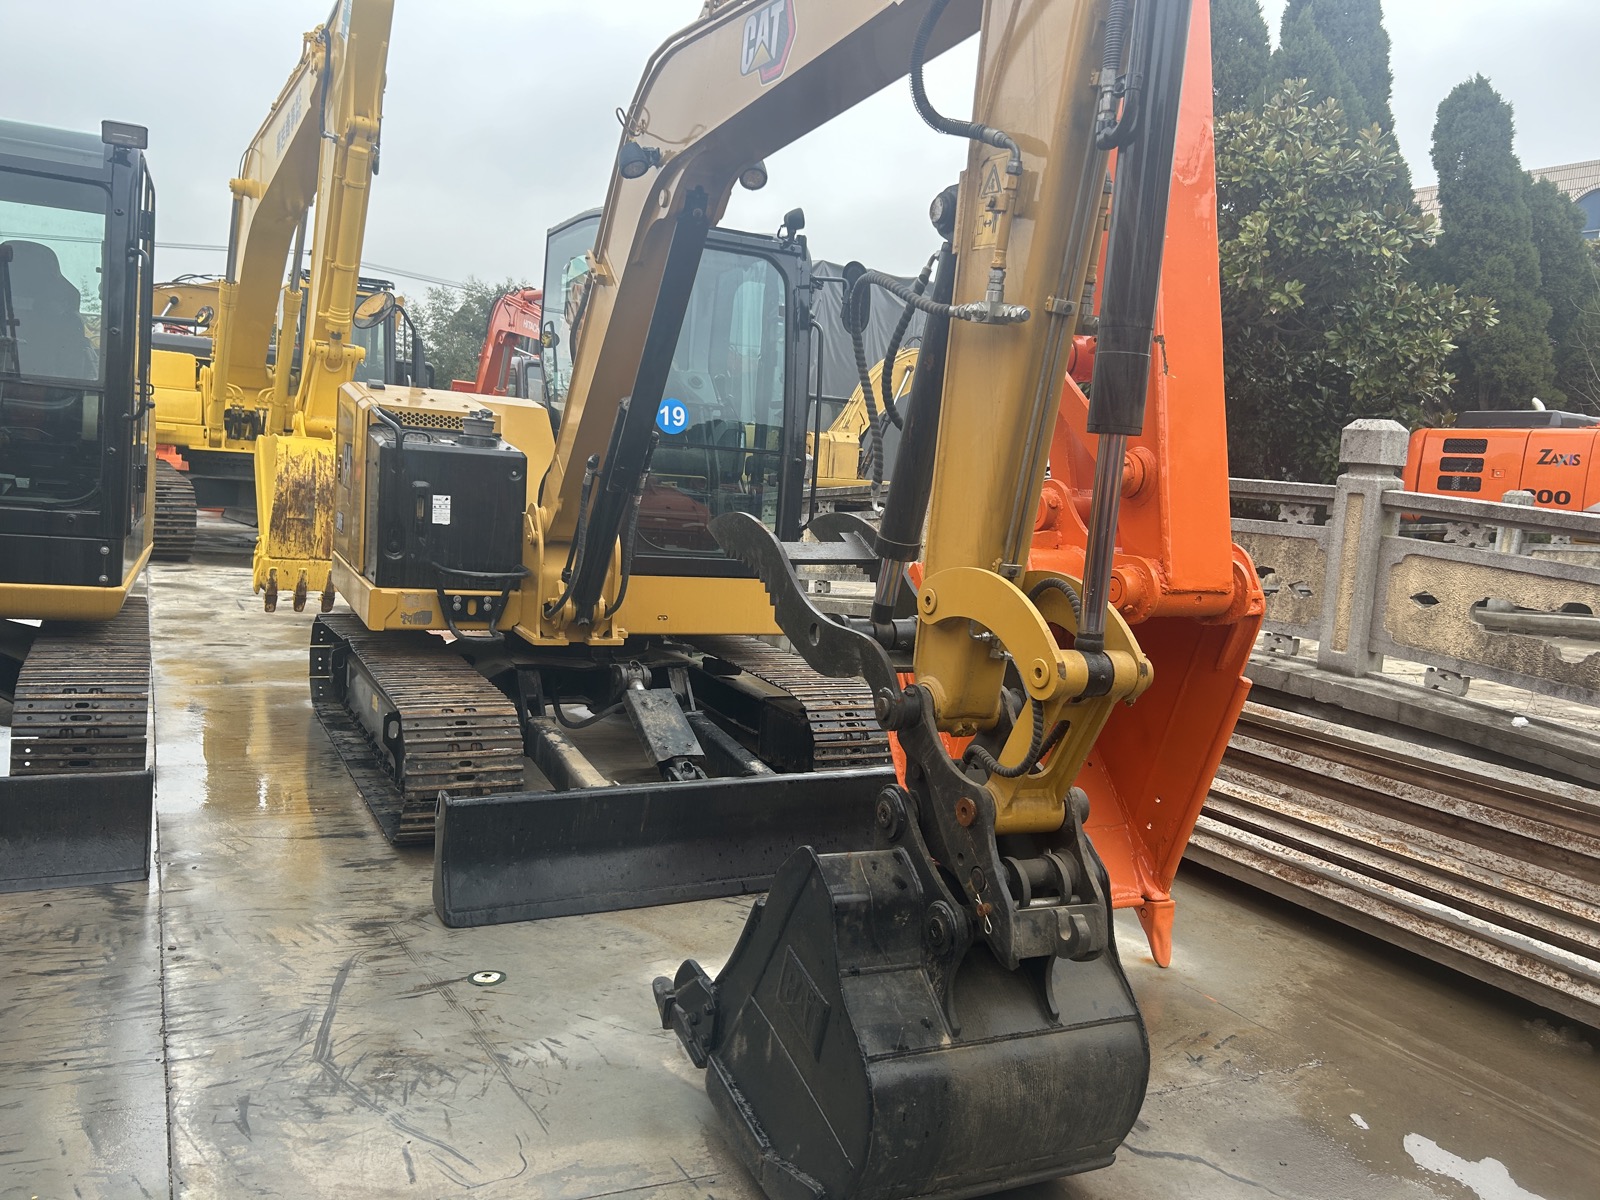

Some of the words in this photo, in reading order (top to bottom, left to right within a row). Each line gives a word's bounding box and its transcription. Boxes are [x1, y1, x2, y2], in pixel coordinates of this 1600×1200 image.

[741, 0, 785, 75] CAT
[523, 319, 540, 333] HITACH
[660, 405, 686, 427] 19
[1536, 449, 1581, 468] ZAXIS
